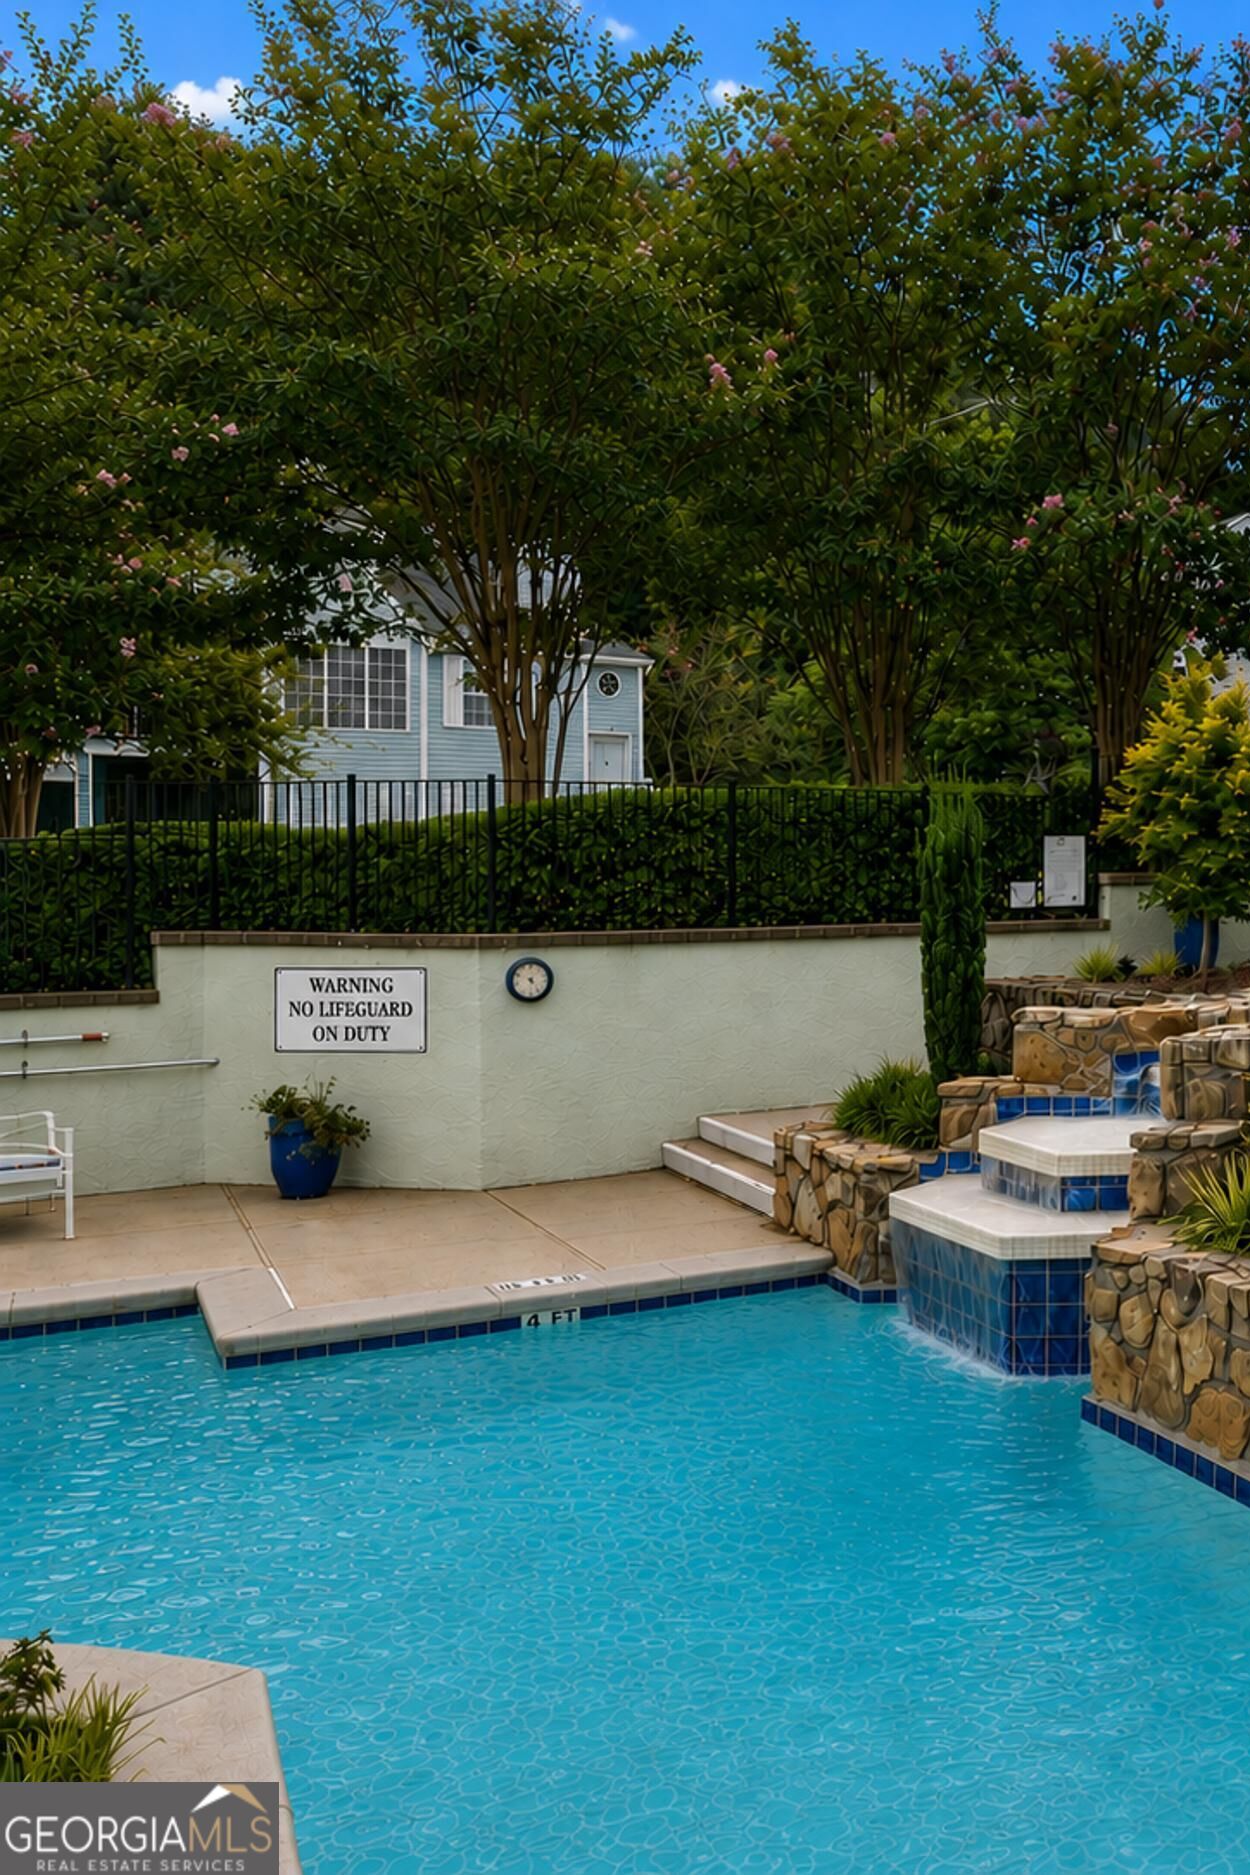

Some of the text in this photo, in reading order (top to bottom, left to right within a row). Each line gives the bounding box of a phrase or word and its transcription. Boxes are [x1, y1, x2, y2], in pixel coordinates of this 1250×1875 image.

[309, 977, 394, 994] WARNING
[288, 1000, 413, 1018] NO LIFEGUARD
[312, 1025, 391, 1042] ON DUTY
[526, 1308, 578, 1329] 4 FT
